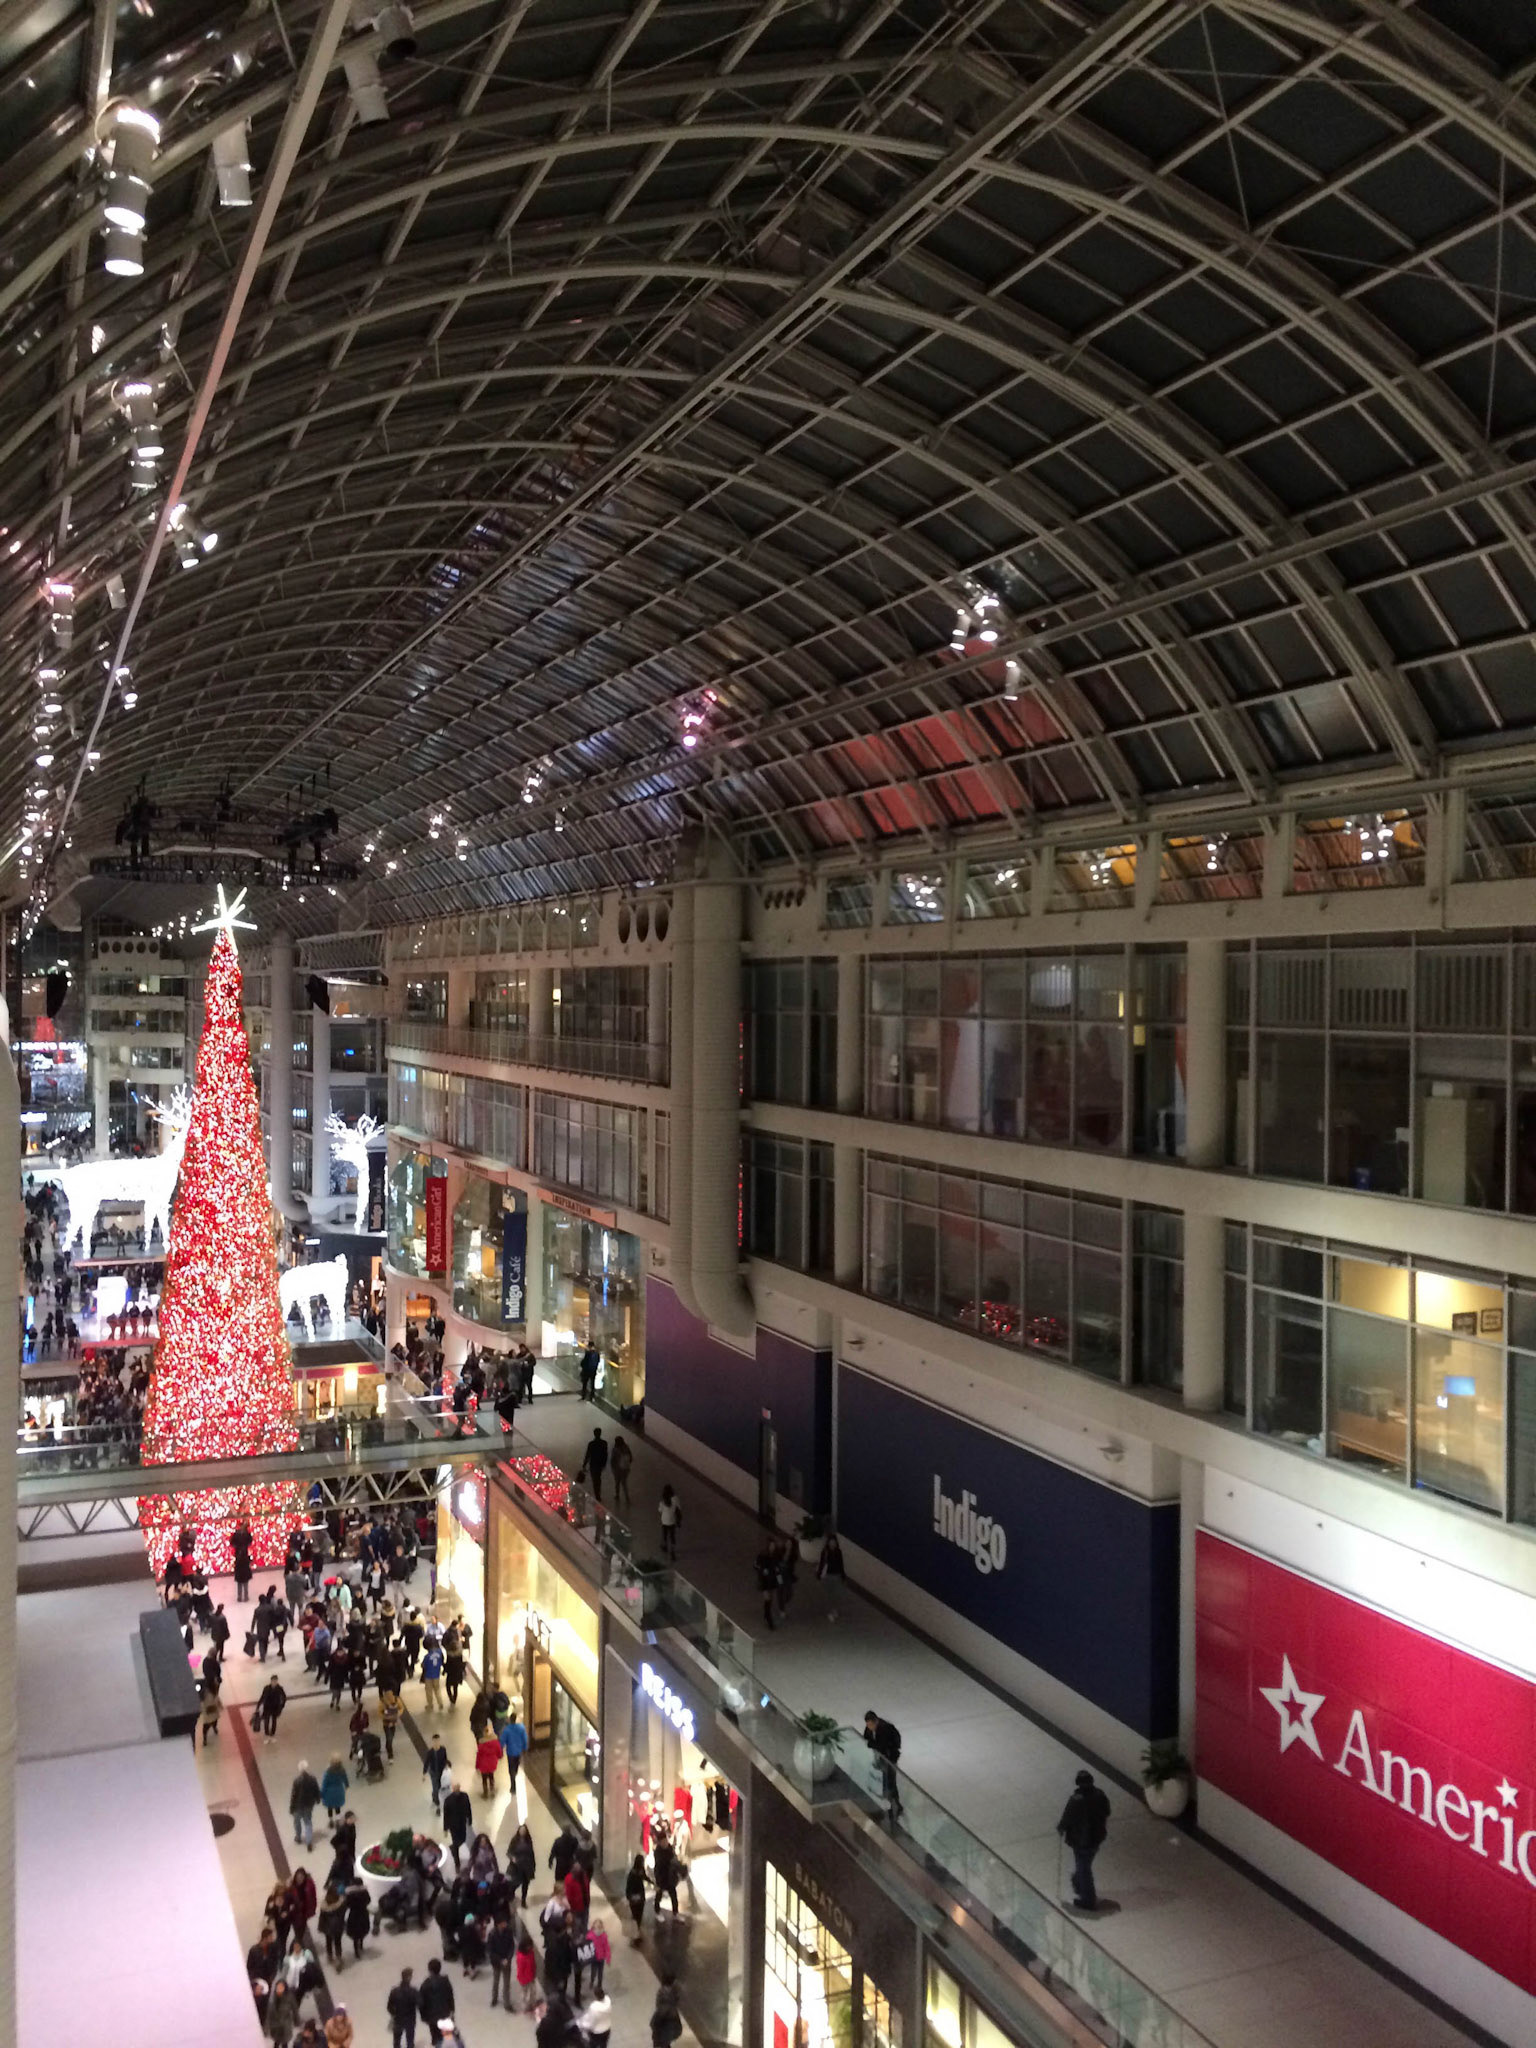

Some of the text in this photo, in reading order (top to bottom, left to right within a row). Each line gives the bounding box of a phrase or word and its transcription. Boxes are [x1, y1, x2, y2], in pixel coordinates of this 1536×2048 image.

[505, 1256, 523, 1320] Indigo Café
[933, 1473, 1007, 1575] Indigo
[795, 1862, 853, 1939] BABATON
